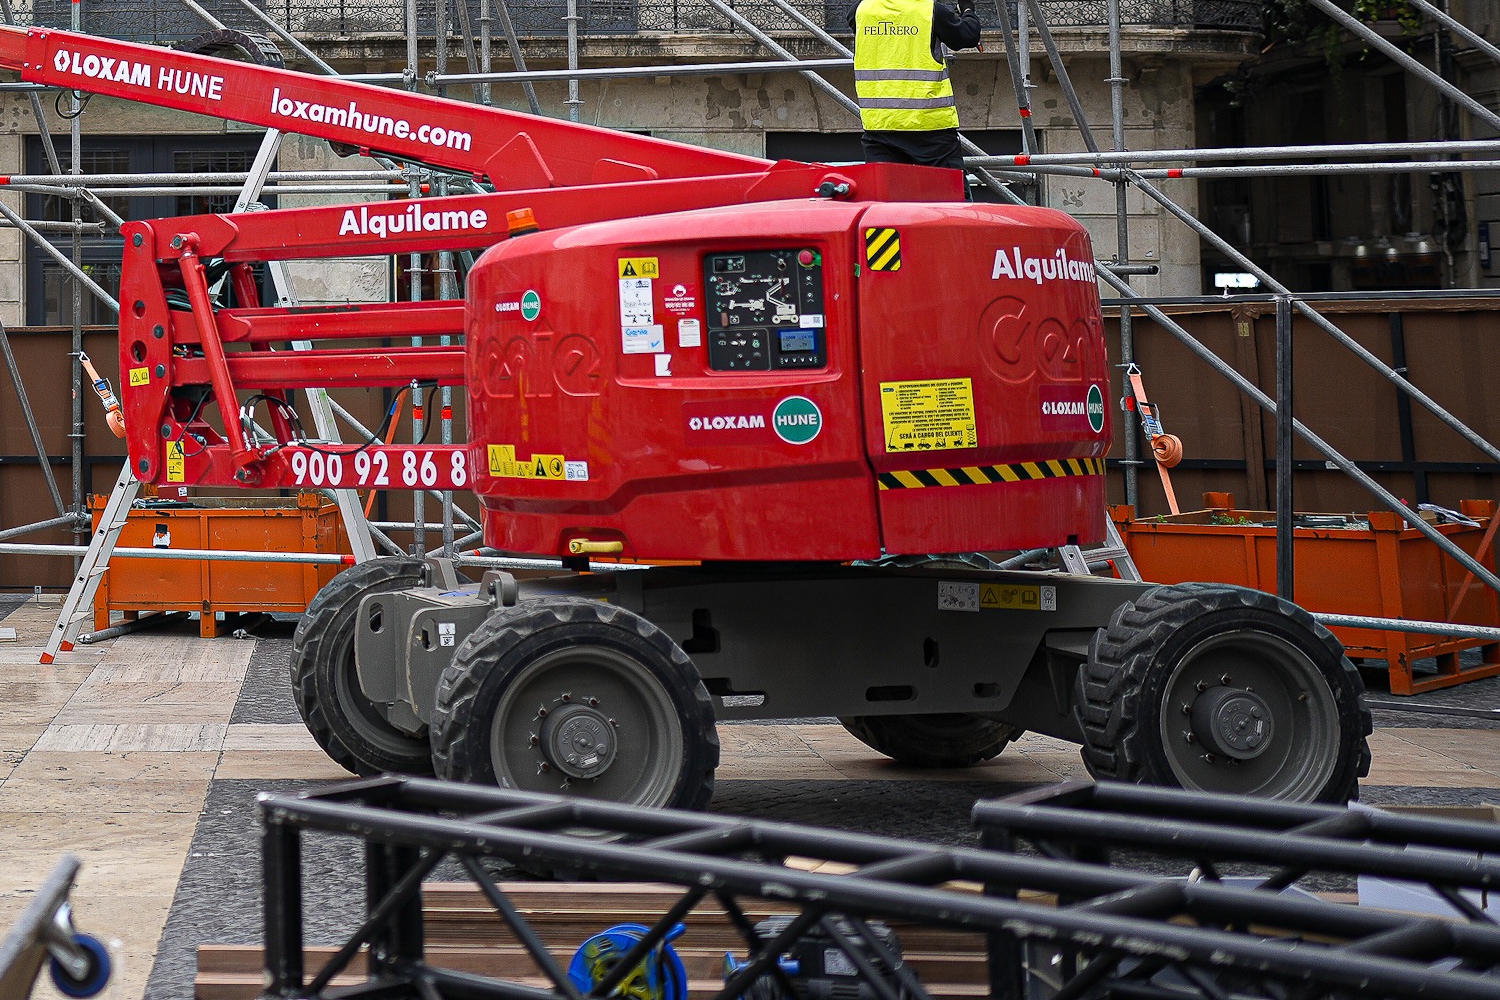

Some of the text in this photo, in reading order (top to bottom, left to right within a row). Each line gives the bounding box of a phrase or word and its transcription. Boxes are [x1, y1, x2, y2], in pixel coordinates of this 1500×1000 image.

[864, 21, 919, 36] FELTRERO
[71, 52, 225, 101] LOXAM HUNE
[270, 87, 473, 152] loxamhune.com
[338, 203, 488, 239] Alquílame
[991, 246, 1096, 285] Alquílame
[522, 301, 539, 309] HUNE
[978, 295, 1110, 384] Geni
[703, 413, 818, 430] LOXAM HUNE
[1052, 402, 1103, 415] LOXAM HUNE
[291, 451, 467, 487] 900 92 86 8
